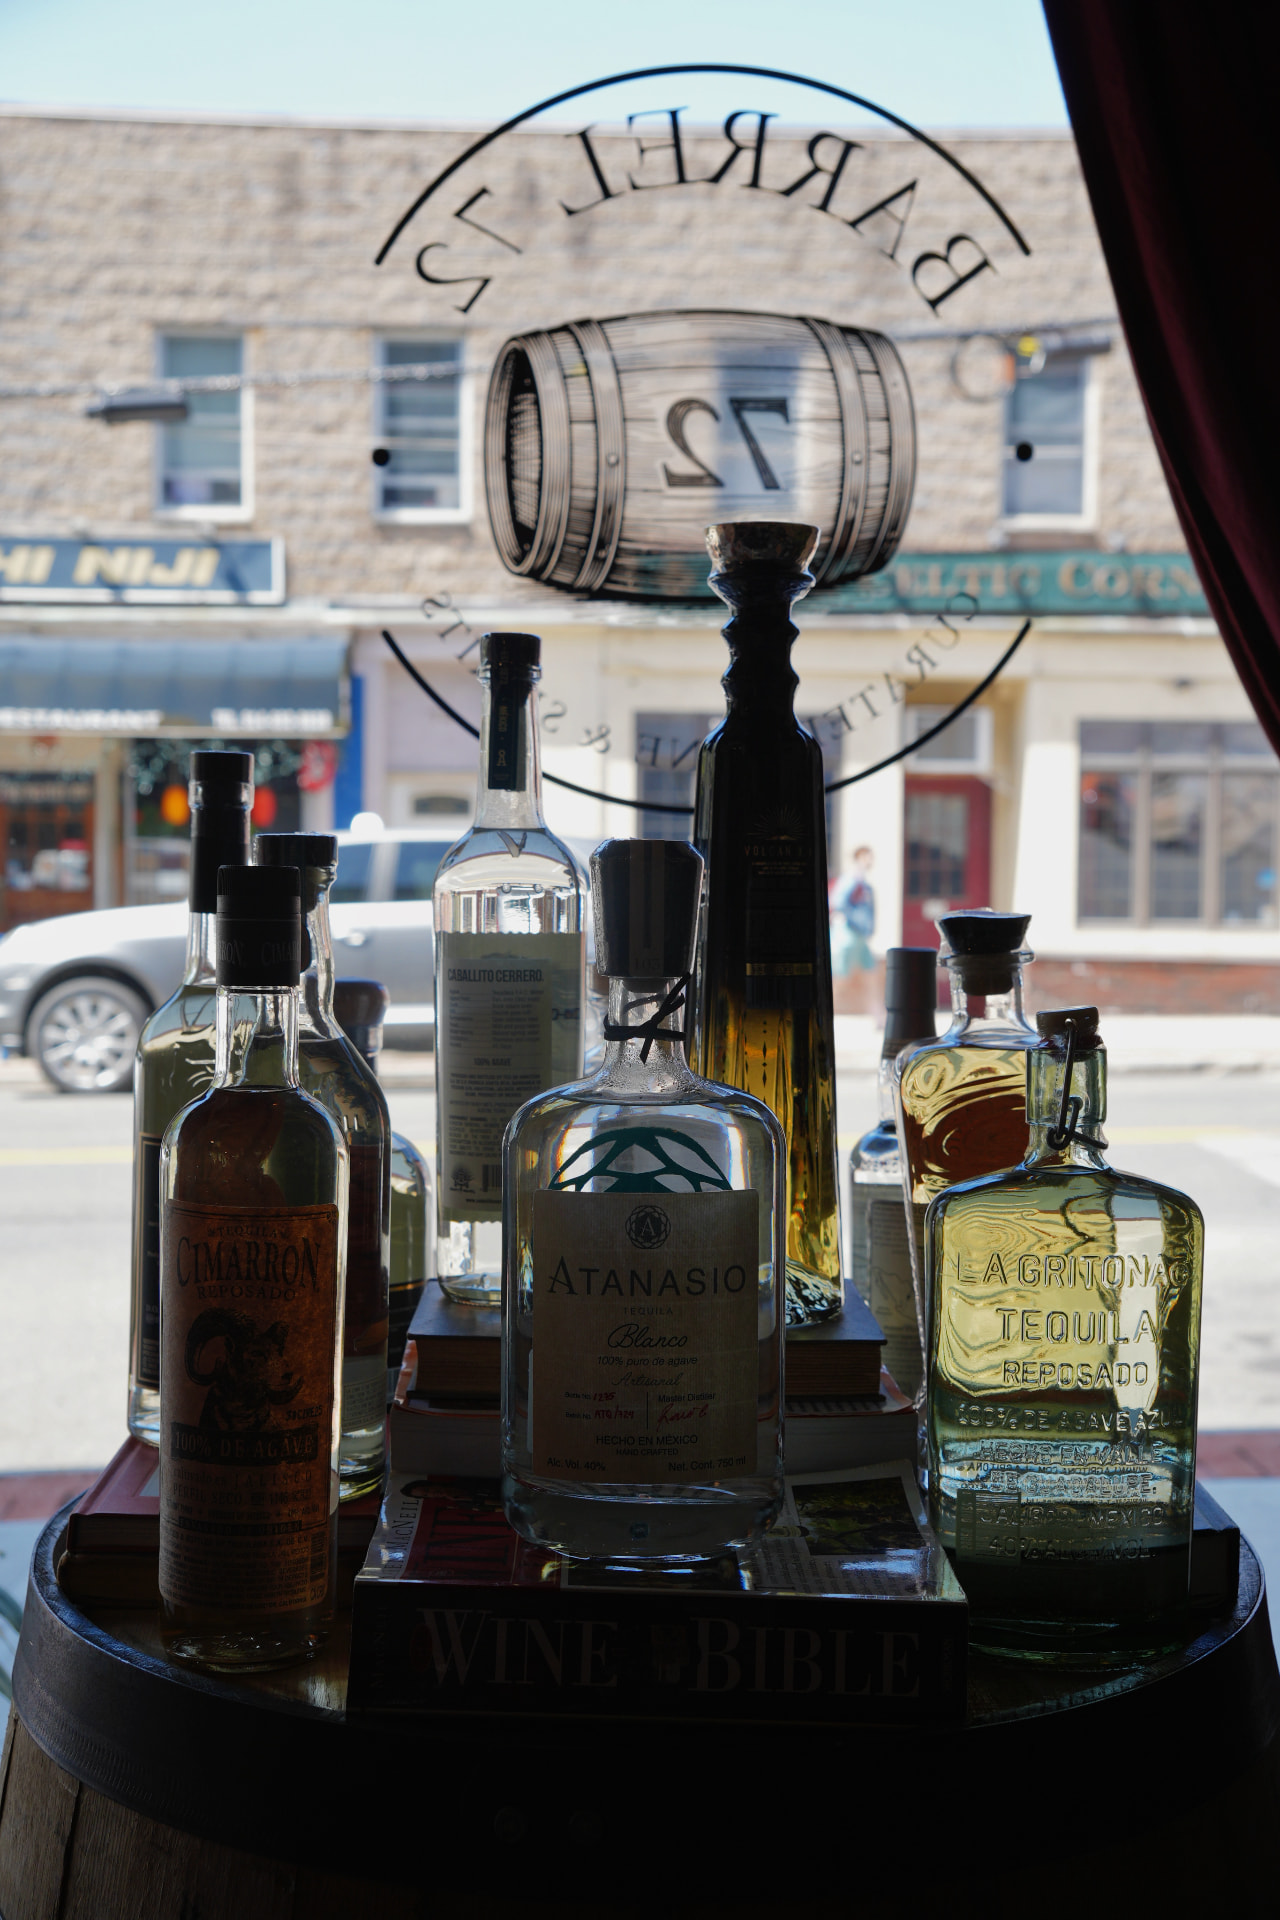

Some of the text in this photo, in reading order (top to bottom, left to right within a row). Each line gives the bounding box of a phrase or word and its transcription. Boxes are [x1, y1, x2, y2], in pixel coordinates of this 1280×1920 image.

[72, 544, 220, 586] NIJI
[448, 968, 494, 982] CABALLITO
[218, 1225, 278, 1239] TEQUILA
[176, 1236, 321, 1293] CIMARRON
[547, 1255, 746, 1297] ATANASIO
[957, 1251, 1170, 1290] LA GRITONA
[196, 1285, 297, 1301] REPOSADO
[623, 1306, 674, 1316] TEQUILA
[607, 1323, 688, 1348] Blanco
[996, 1307, 1158, 1345] TEQUILA
[597, 1356, 698, 1368] 100% puro de agave
[1003, 1359, 1149, 1389] REPOSADO
[611, 1371, 684, 1387] Artisanal
[658, 1392, 716, 1402] Master Distiller
[957, 1402, 1017, 1430] 100%
[1023, 1409, 1050, 1430] DE
[1056, 1410, 1130, 1432] AGAVE
[174, 1430, 315, 1458] 100% DE AGAVE
[595, 1435, 636, 1446] HECHO
[638, 1436, 654, 1446] EN
[640, 1448, 679, 1456] CRAFTED
[1060, 1445, 1090, 1465] EN
[1093, 1439, 1165, 1465] VALLE
[547, 1457, 606, 1471] Alc. Vol. 40%
[690, 1459, 715, 1470] Cont.
[718, 1458, 734, 1468] 750
[735, 1456, 746, 1466] ml
[386, 1499, 420, 1551] MACNEIL
[416, 1607, 620, 1690] WINE
[687, 1615, 922, 1699] BIBLE
